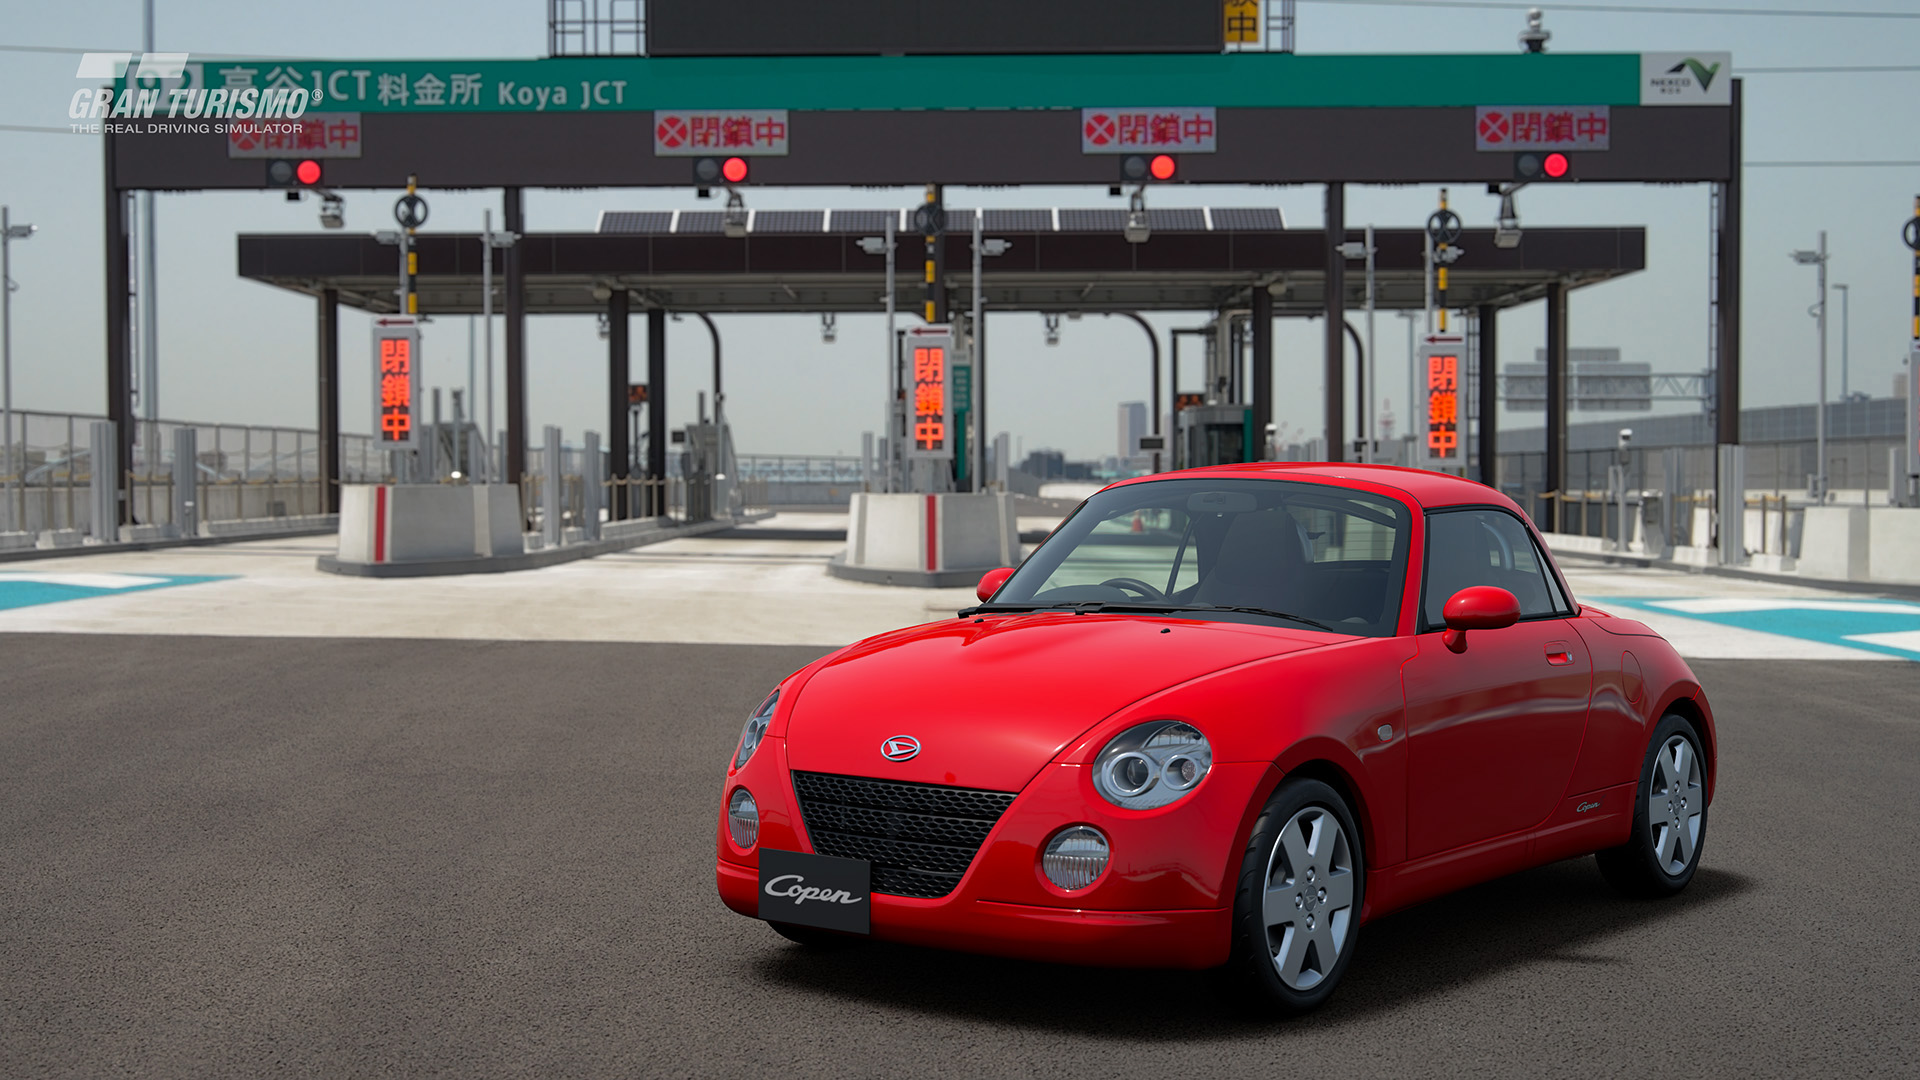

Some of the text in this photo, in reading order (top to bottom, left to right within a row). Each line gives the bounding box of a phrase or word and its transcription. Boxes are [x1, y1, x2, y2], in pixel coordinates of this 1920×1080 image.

[1224, 0, 1257, 41] 中
[498, 81, 567, 111] Koya
[580, 80, 627, 110] JCT
[690, 115, 785, 148] 閉鎖中
[1118, 112, 1213, 145] 閉鎖中
[1512, 111, 1607, 143] 閉鎖中
[381, 339, 410, 441] 閉鎖中
[914, 348, 944, 450] 閉鎖中
[1428, 356, 1457, 459] 閉鎖中
[764, 874, 862, 905] Copen
